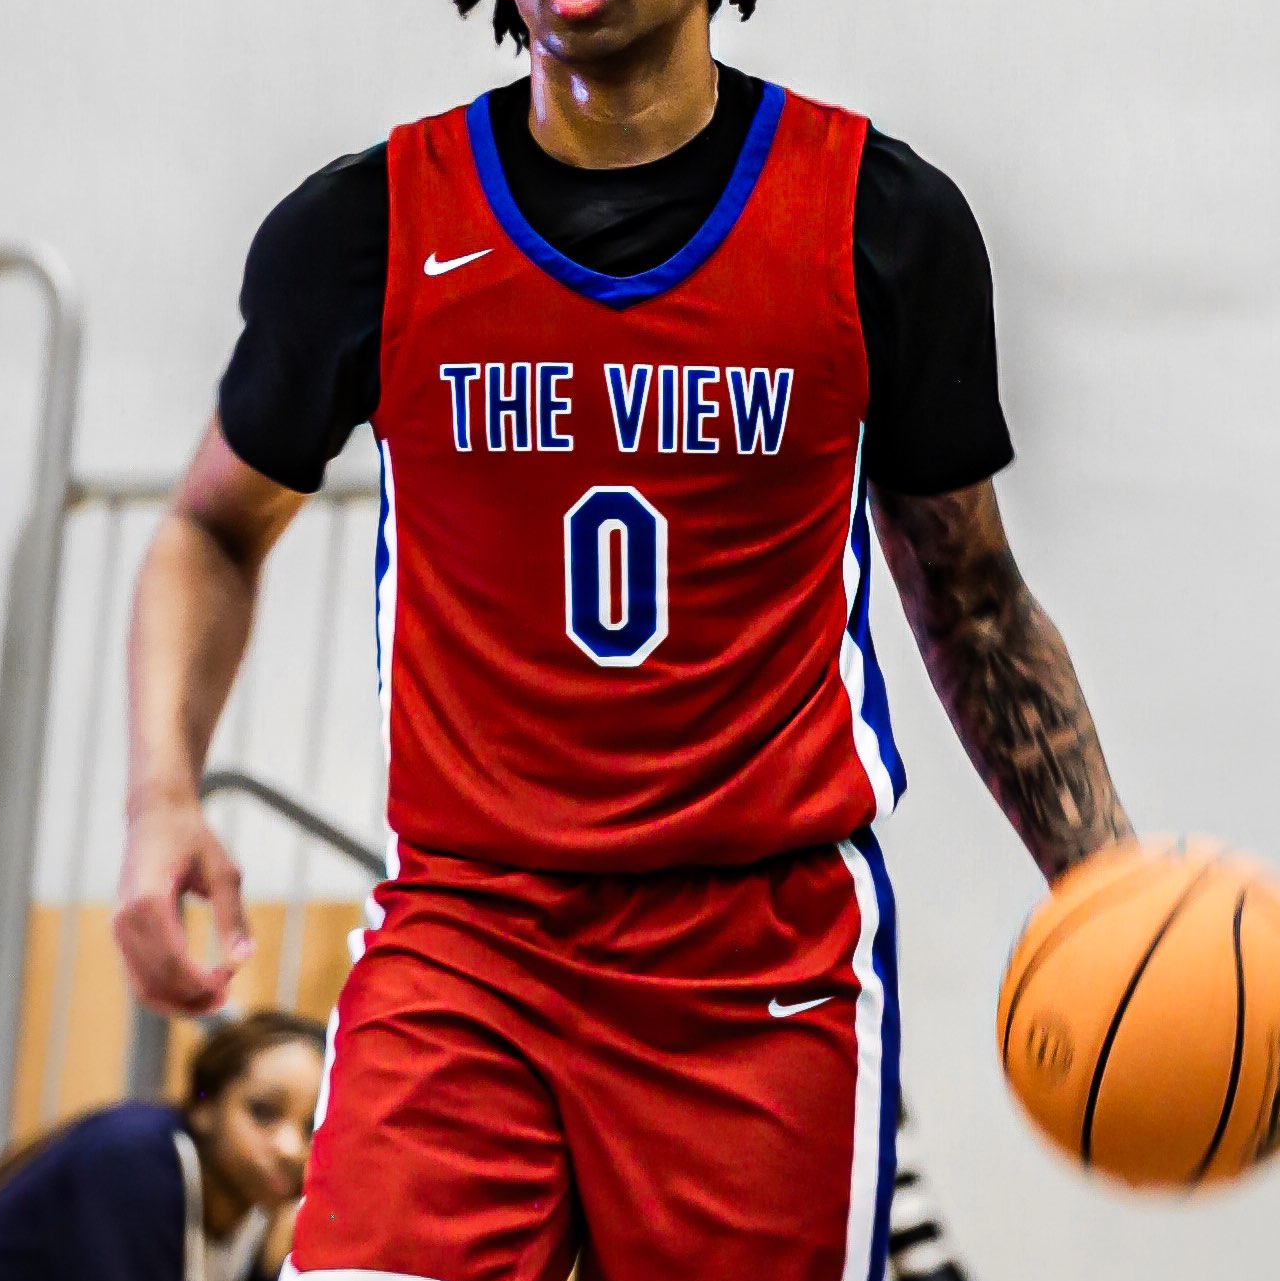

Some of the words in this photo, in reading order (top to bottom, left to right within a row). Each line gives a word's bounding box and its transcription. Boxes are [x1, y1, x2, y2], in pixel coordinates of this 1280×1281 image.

[439, 362, 574, 452] THE
[604, 364, 794, 455] VIEW
[563, 485, 668, 667] 0
